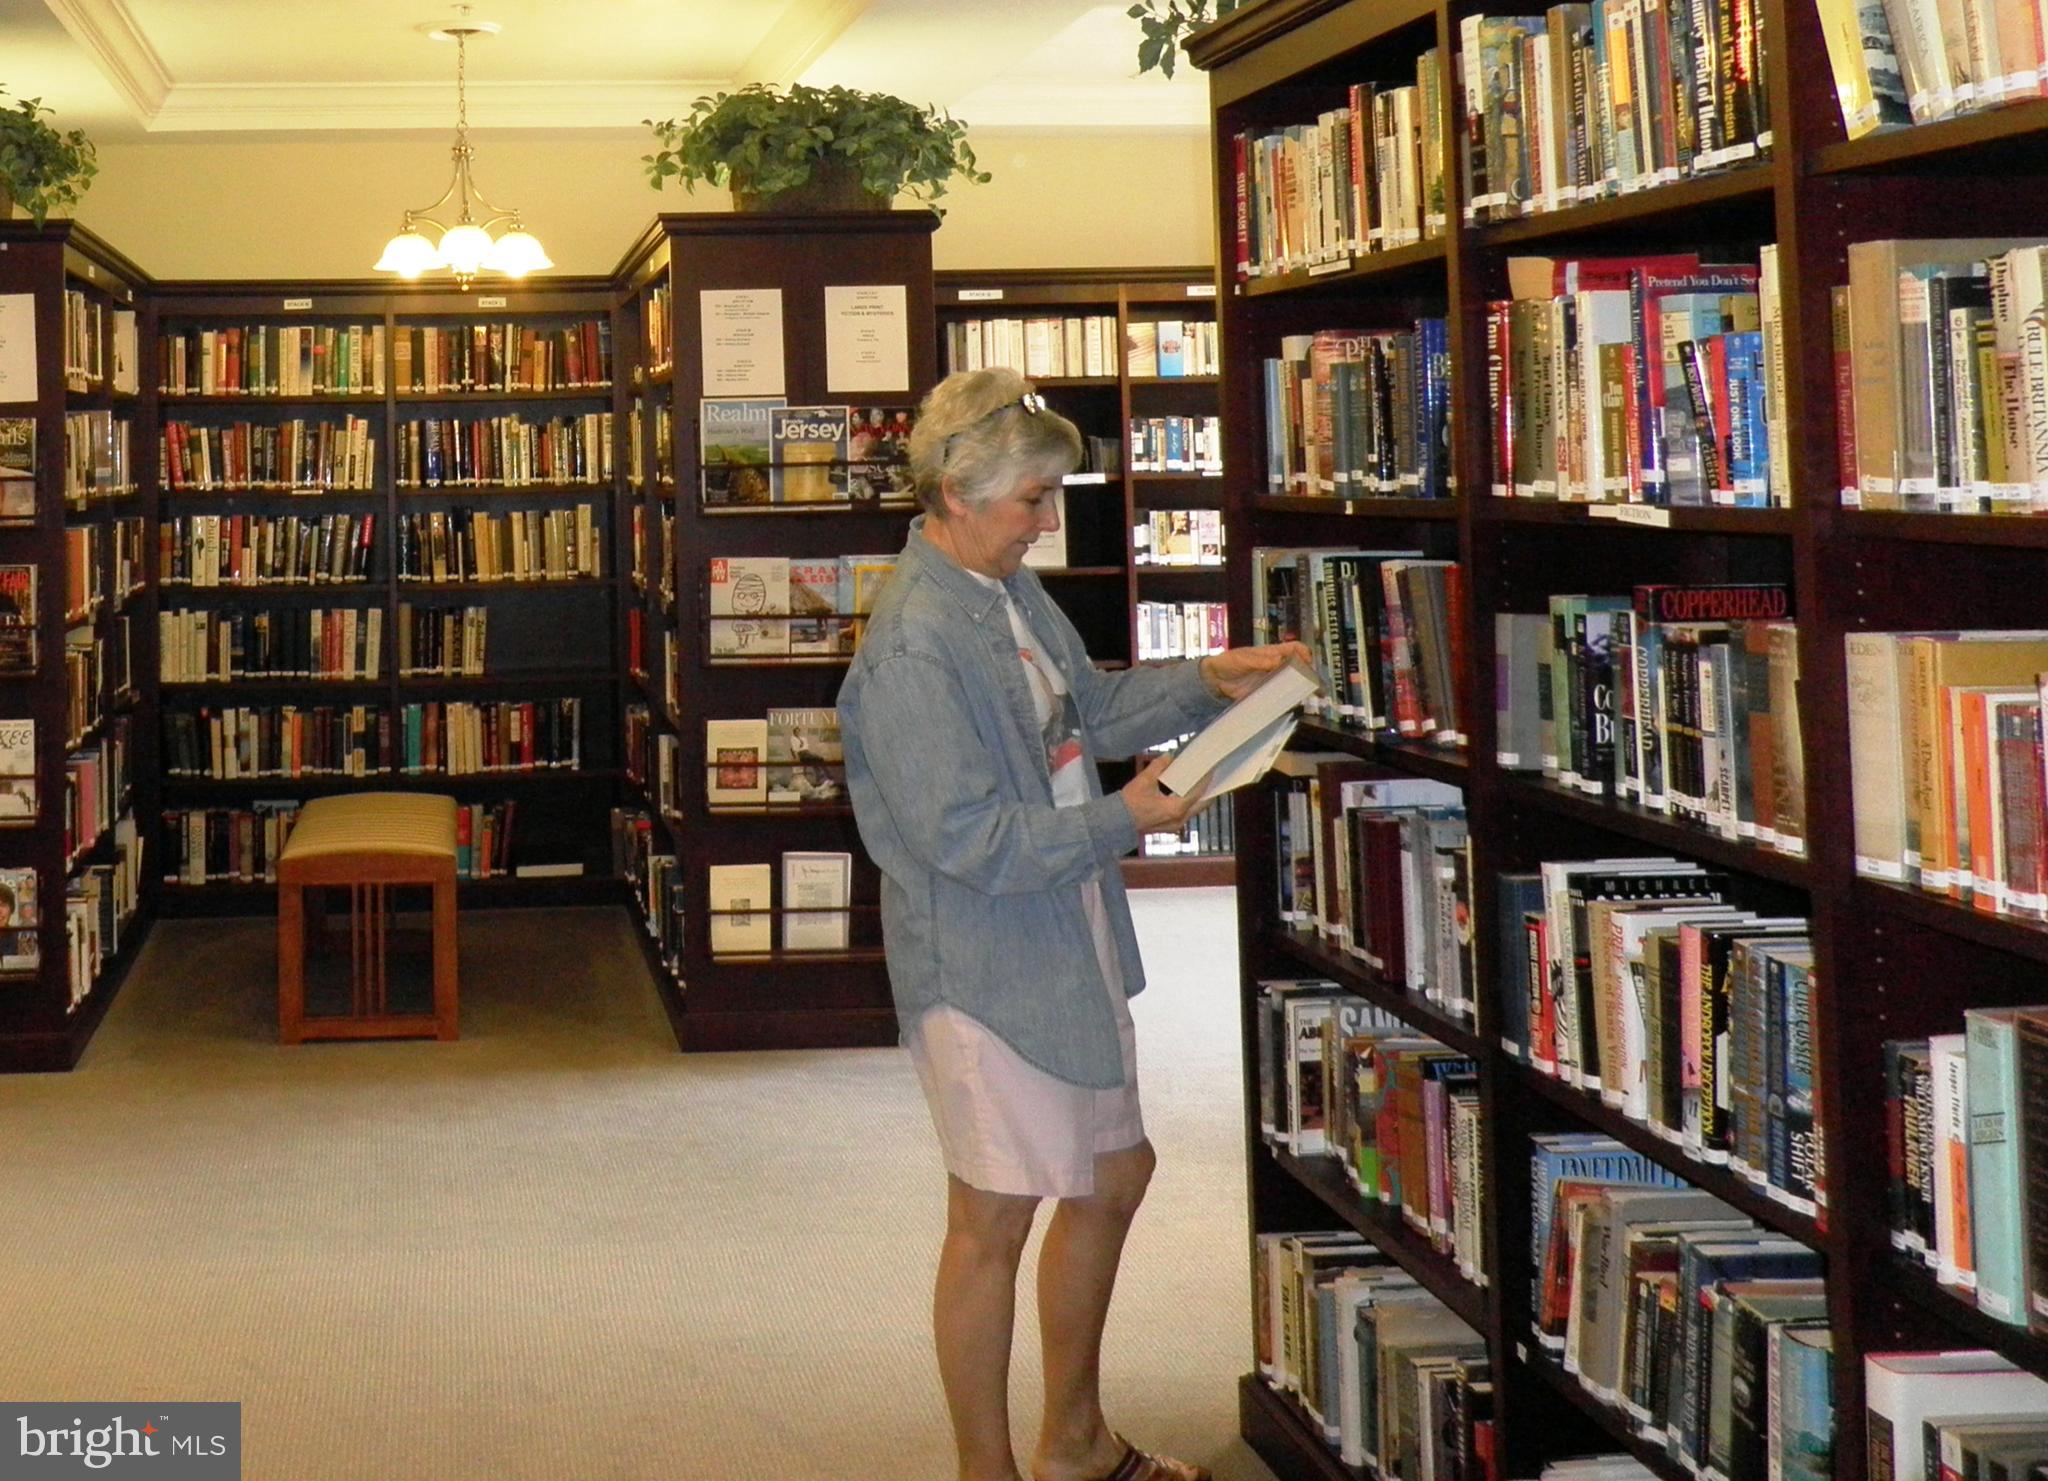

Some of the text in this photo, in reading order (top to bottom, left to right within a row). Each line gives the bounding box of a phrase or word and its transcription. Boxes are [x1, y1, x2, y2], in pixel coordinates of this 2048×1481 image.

[1694, 44, 1710, 84] Debt
[1722, 15, 1737, 139] and The Dragon
[1697, 86, 1713, 103] of
[1648, 276, 1687, 287] Pretend
[1689, 275, 1709, 286] You
[1711, 274, 1739, 286] Don't
[1995, 260, 2010, 323] Daphne
[1487, 313, 1502, 413] Tom Clancy
[1935, 334, 1944, 360] SAND
[1543, 354, 1552, 428] Tom Clancy
[1839, 364, 1850, 383] The
[1936, 363, 1945, 384] AND
[707, 404, 767, 423] Realm
[1729, 377, 1743, 460] JUST ONE LOOK
[2003, 361, 2020, 450] The House
[2027, 326, 2048, 474] RULE BRITANNIA
[775, 418, 845, 442] Jersey
[1843, 442, 1854, 474] Moth
[1619, 506, 1652, 520] FICTION
[207, 518, 218, 553] Dutch
[1661, 587, 1787, 619] COPPERHEAD
[1636, 646, 1654, 750] COPPERHEAD
[1720, 767, 1730, 812] SCARPET
[1605, 879, 1711, 892] MICHAEL
[1605, 935, 1614, 979] Secret
[1606, 984, 1615, 995] of
[1611, 925, 1628, 1068] PREY MICHAEL CRICHTON
[1606, 1002, 1617, 1042] Santa
[1795, 980, 1811, 1075] CLIVE CUSSLER
[1608, 1046, 1619, 1091] Vittori
[1701, 964, 1713, 1135] THE ANDROPOV DECEPTION
[1949, 1061, 1960, 1128] Jasper Fforde
[1790, 1131, 1804, 1183] SHIFT
[1803, 1130, 1815, 1190] POLAR
[1903, 1095, 1920, 1189] FAULKNER
[1561, 1156, 1615, 1177] JANET
